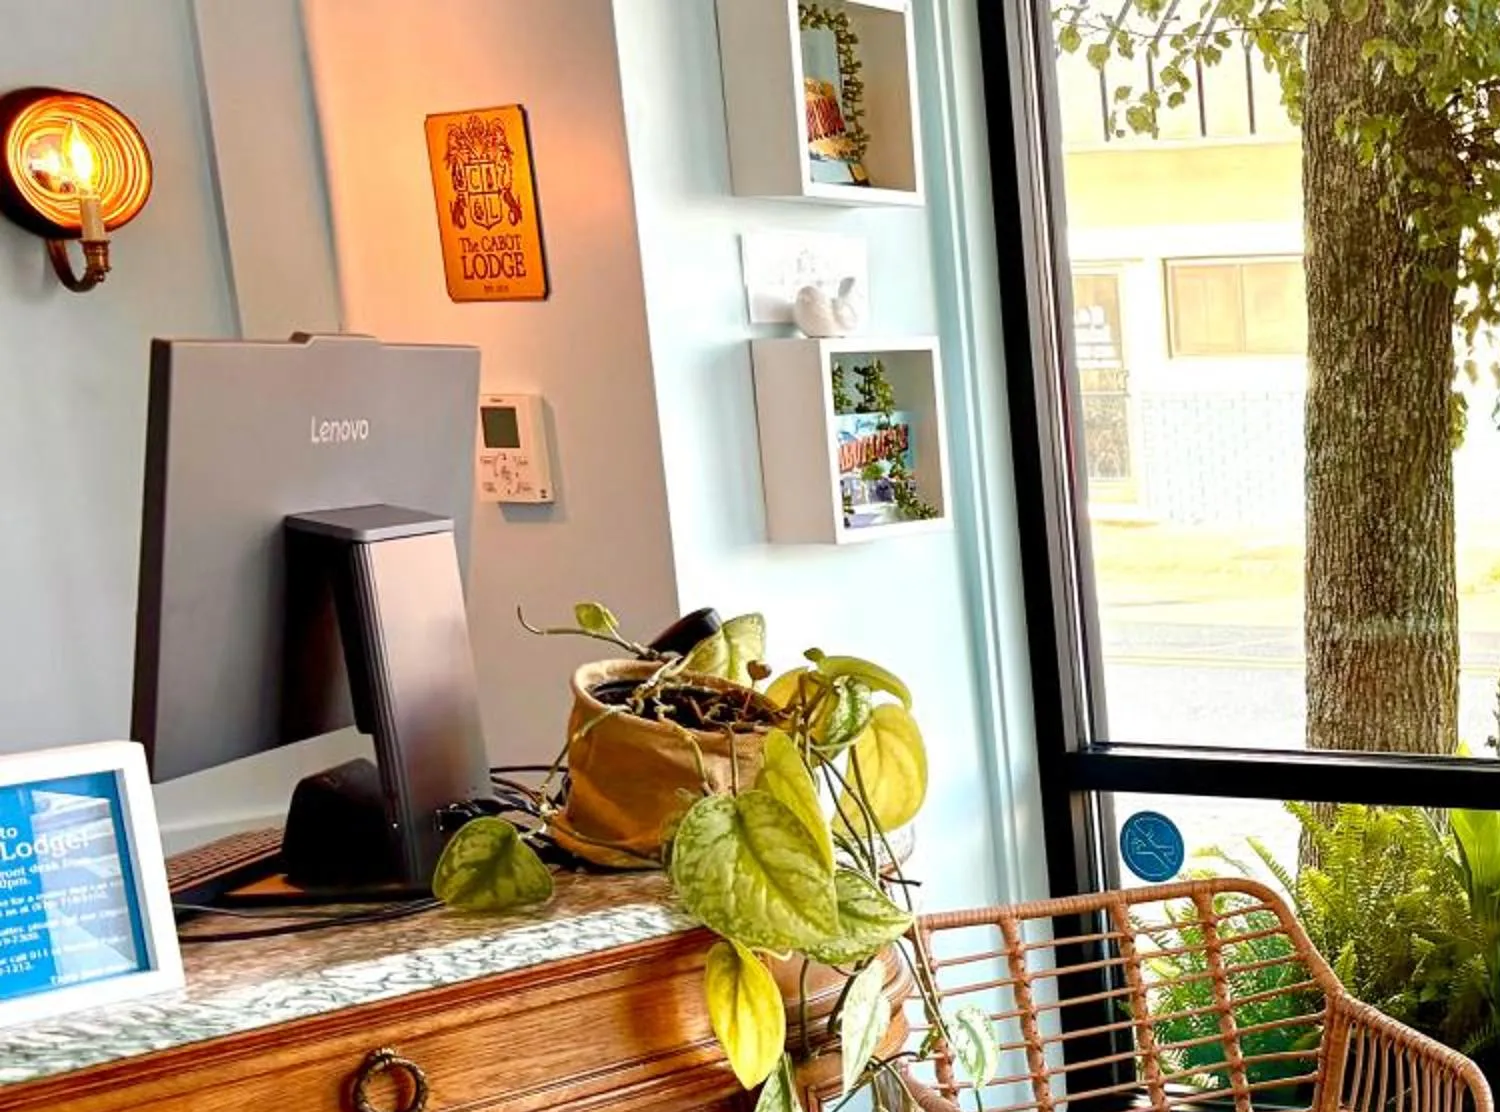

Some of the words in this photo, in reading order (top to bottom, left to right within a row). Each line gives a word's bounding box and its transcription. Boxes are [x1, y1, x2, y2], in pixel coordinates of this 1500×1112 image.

[481, 234, 522, 252] CABOT
[461, 251, 527, 280] LODGE
[311, 416, 369, 443] Lenovo
